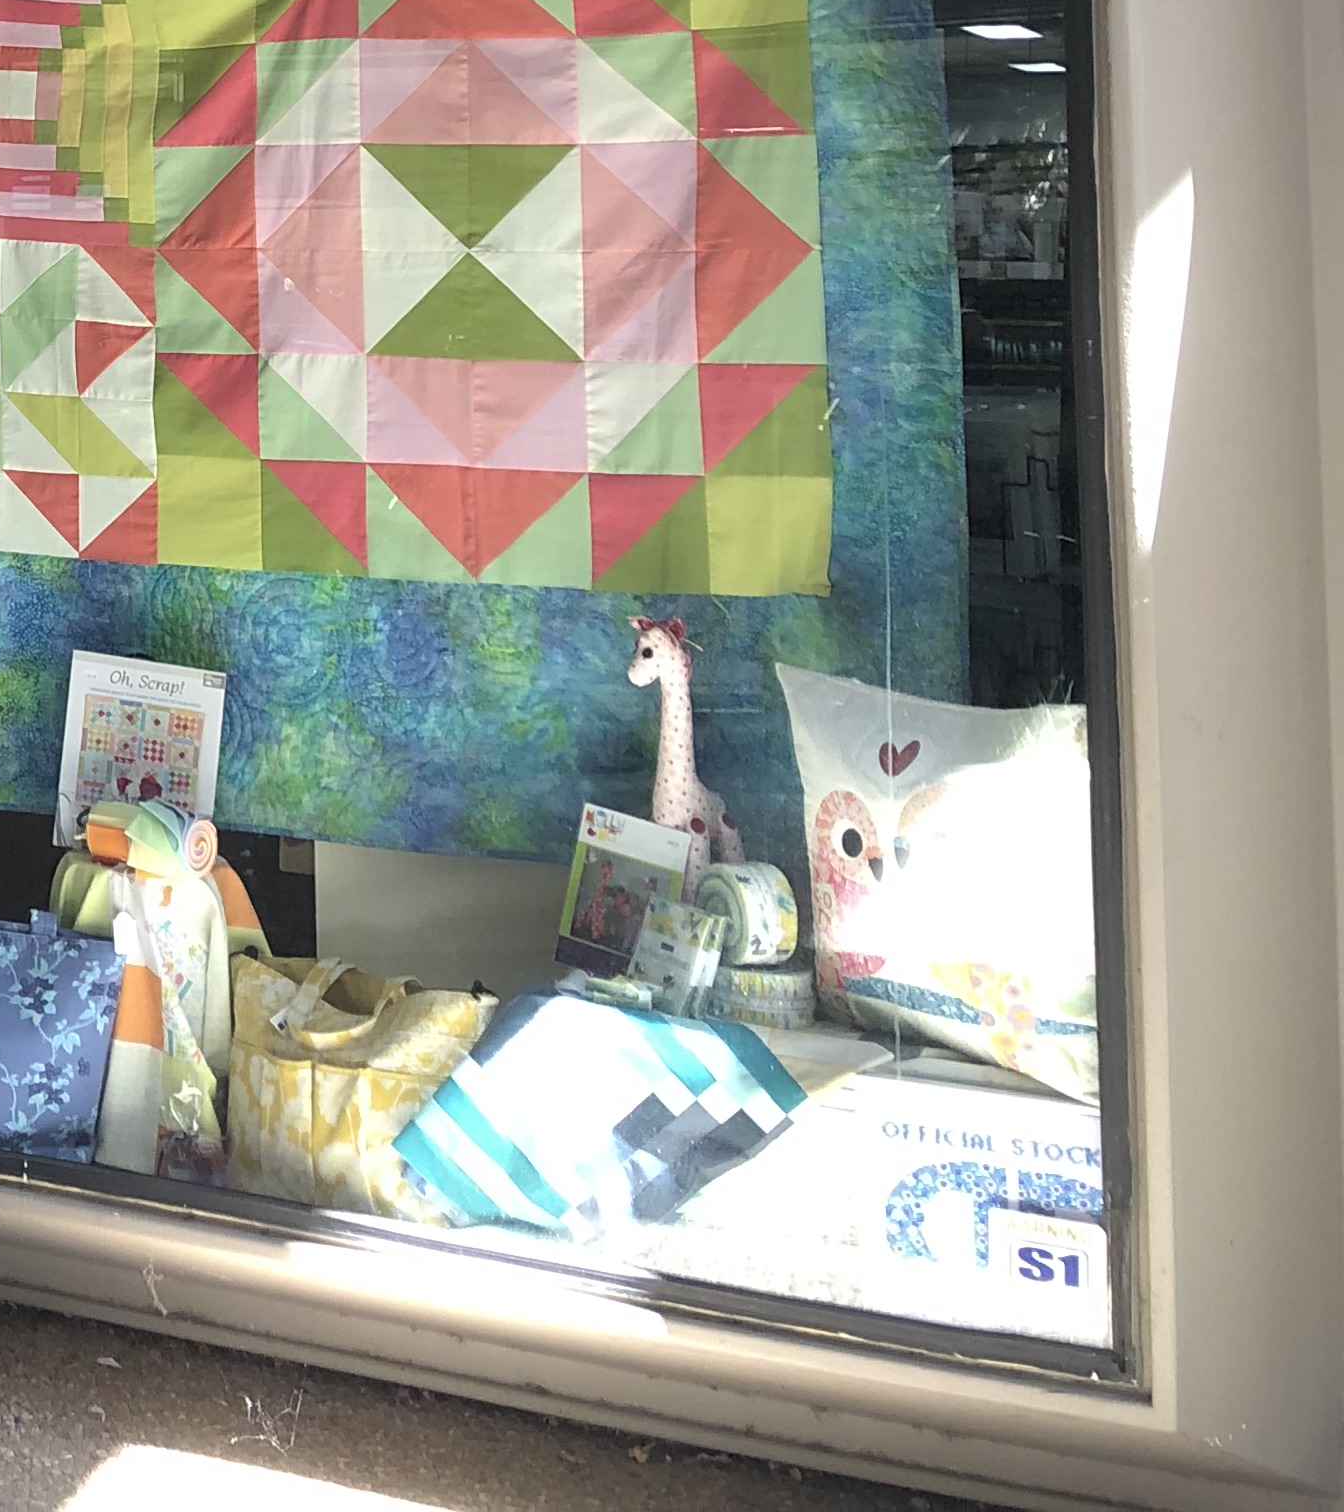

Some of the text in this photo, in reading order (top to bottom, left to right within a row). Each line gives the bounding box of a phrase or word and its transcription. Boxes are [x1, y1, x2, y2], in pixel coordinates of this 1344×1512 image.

[109, 670, 134, 688] Oh,
[138, 674, 186, 696] Scrap!
[882, 1121, 1101, 1168] OFFICIAL STOCK
[1018, 1246, 1079, 1288] S1
